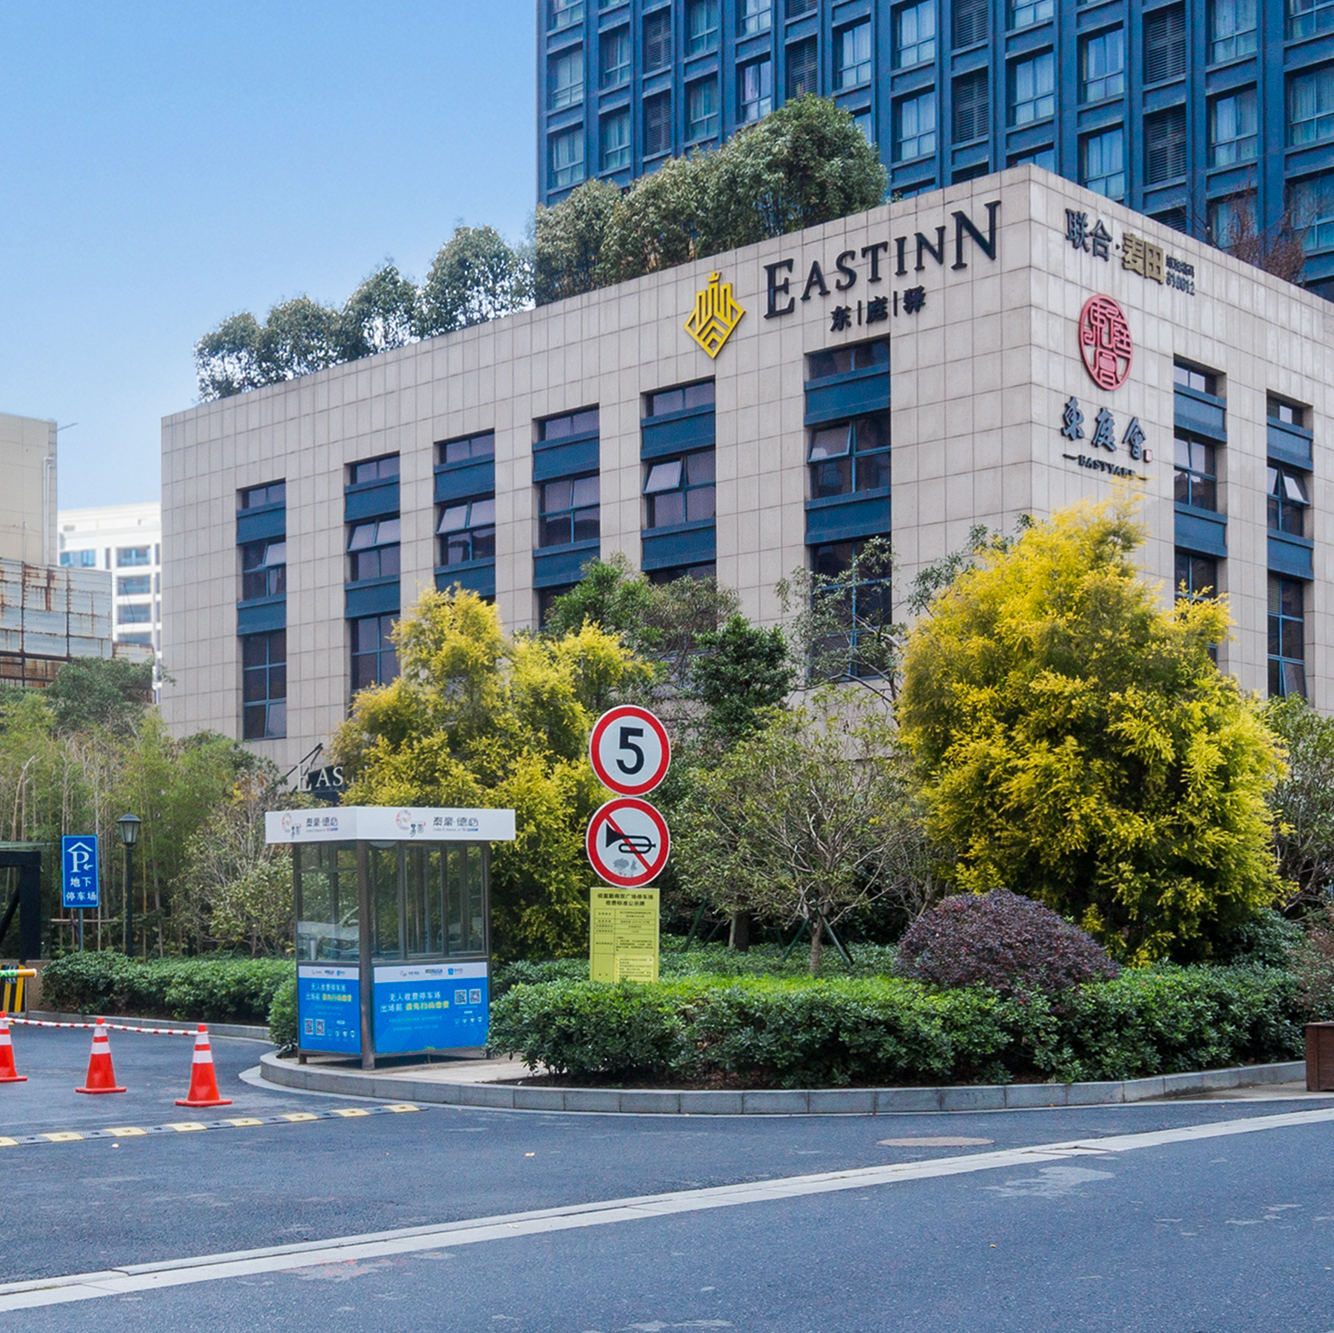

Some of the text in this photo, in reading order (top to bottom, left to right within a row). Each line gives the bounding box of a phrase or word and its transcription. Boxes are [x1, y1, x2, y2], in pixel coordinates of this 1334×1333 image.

[763, 200, 1001, 320] EASTINN
[616, 726, 645, 775] 5
[70, 876, 92, 888] 地下
[66, 891, 97, 901] 停车场
[389, 991, 441, 1002] 无人收费停车场
[380, 1004, 403, 1013] 出场前
